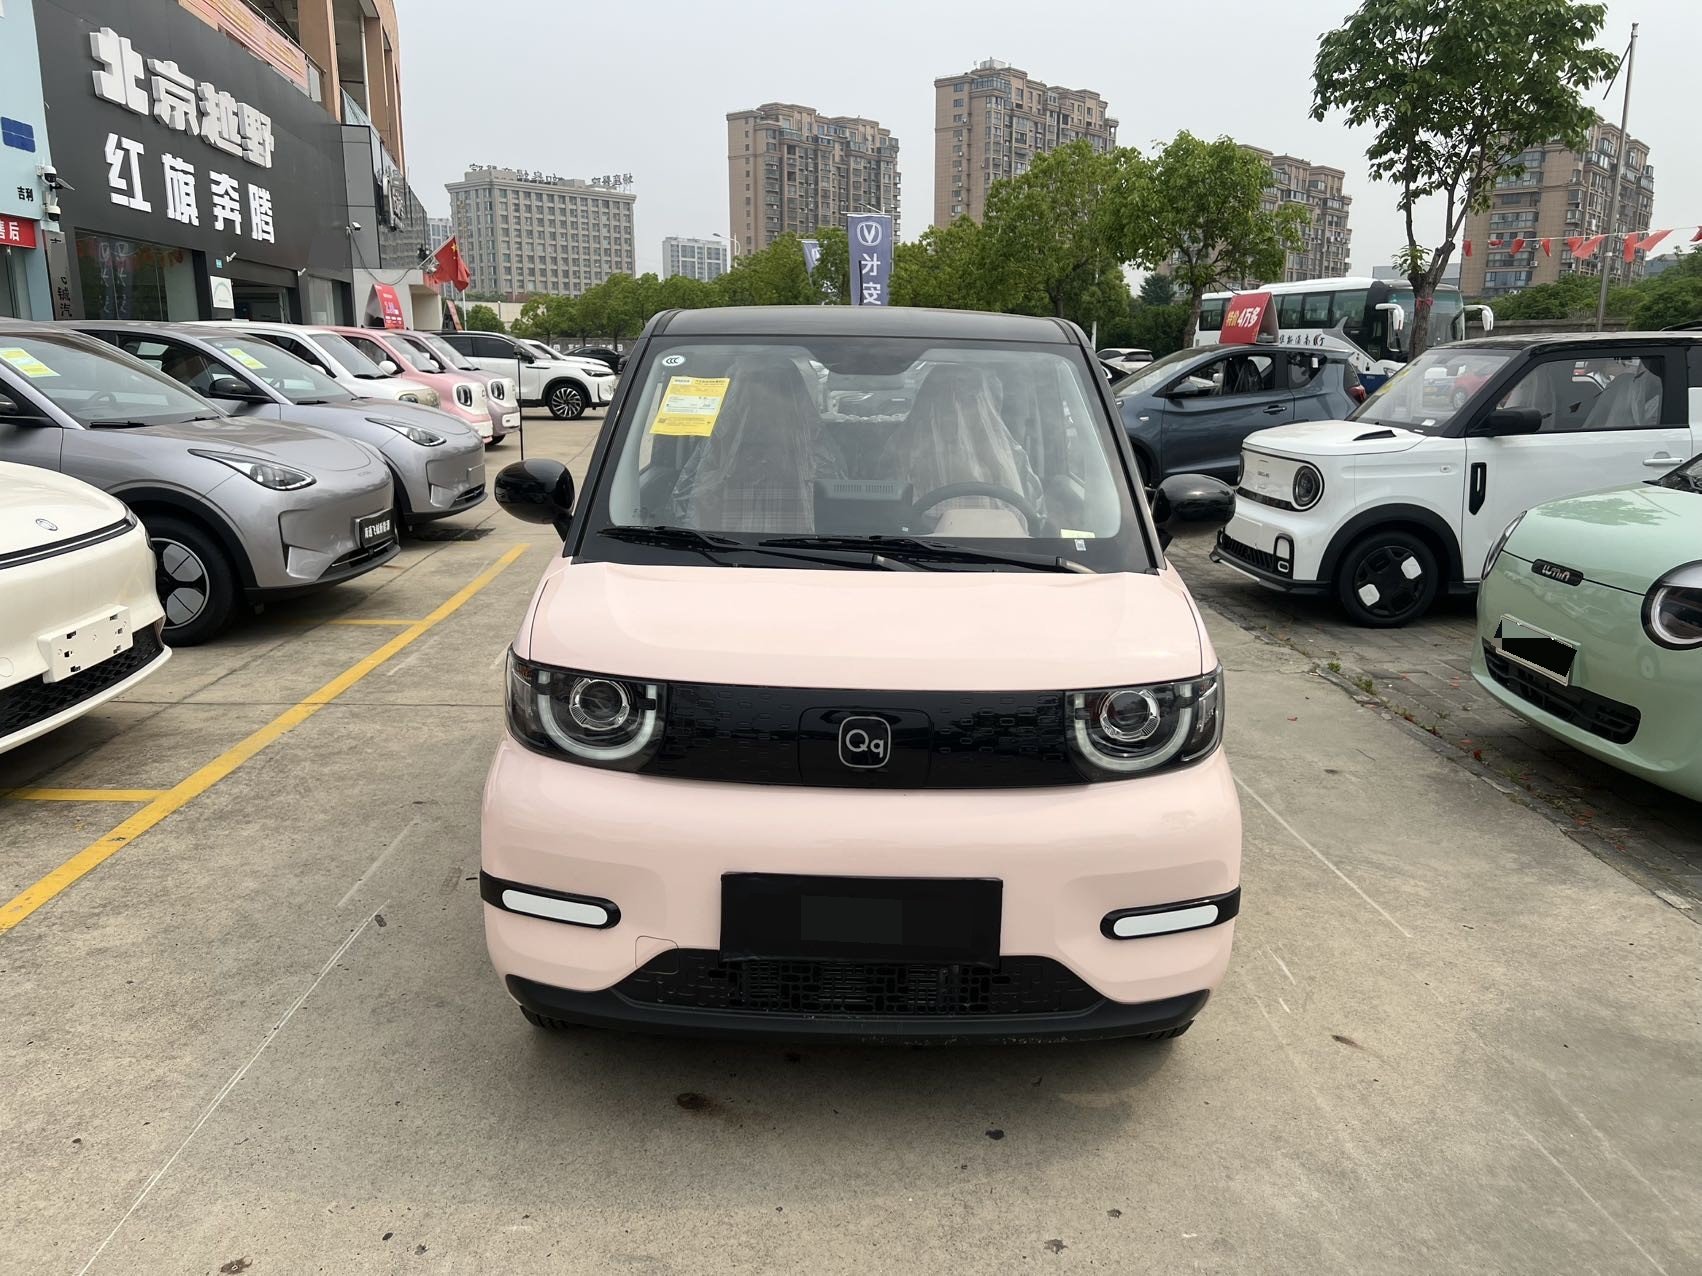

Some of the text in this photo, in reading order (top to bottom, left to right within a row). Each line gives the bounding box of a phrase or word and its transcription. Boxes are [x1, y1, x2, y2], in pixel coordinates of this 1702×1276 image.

[90, 27, 275, 169] 北京越野
[17, 186, 34, 202] 吉利
[104, 132, 275, 244] 红旗奔腾
